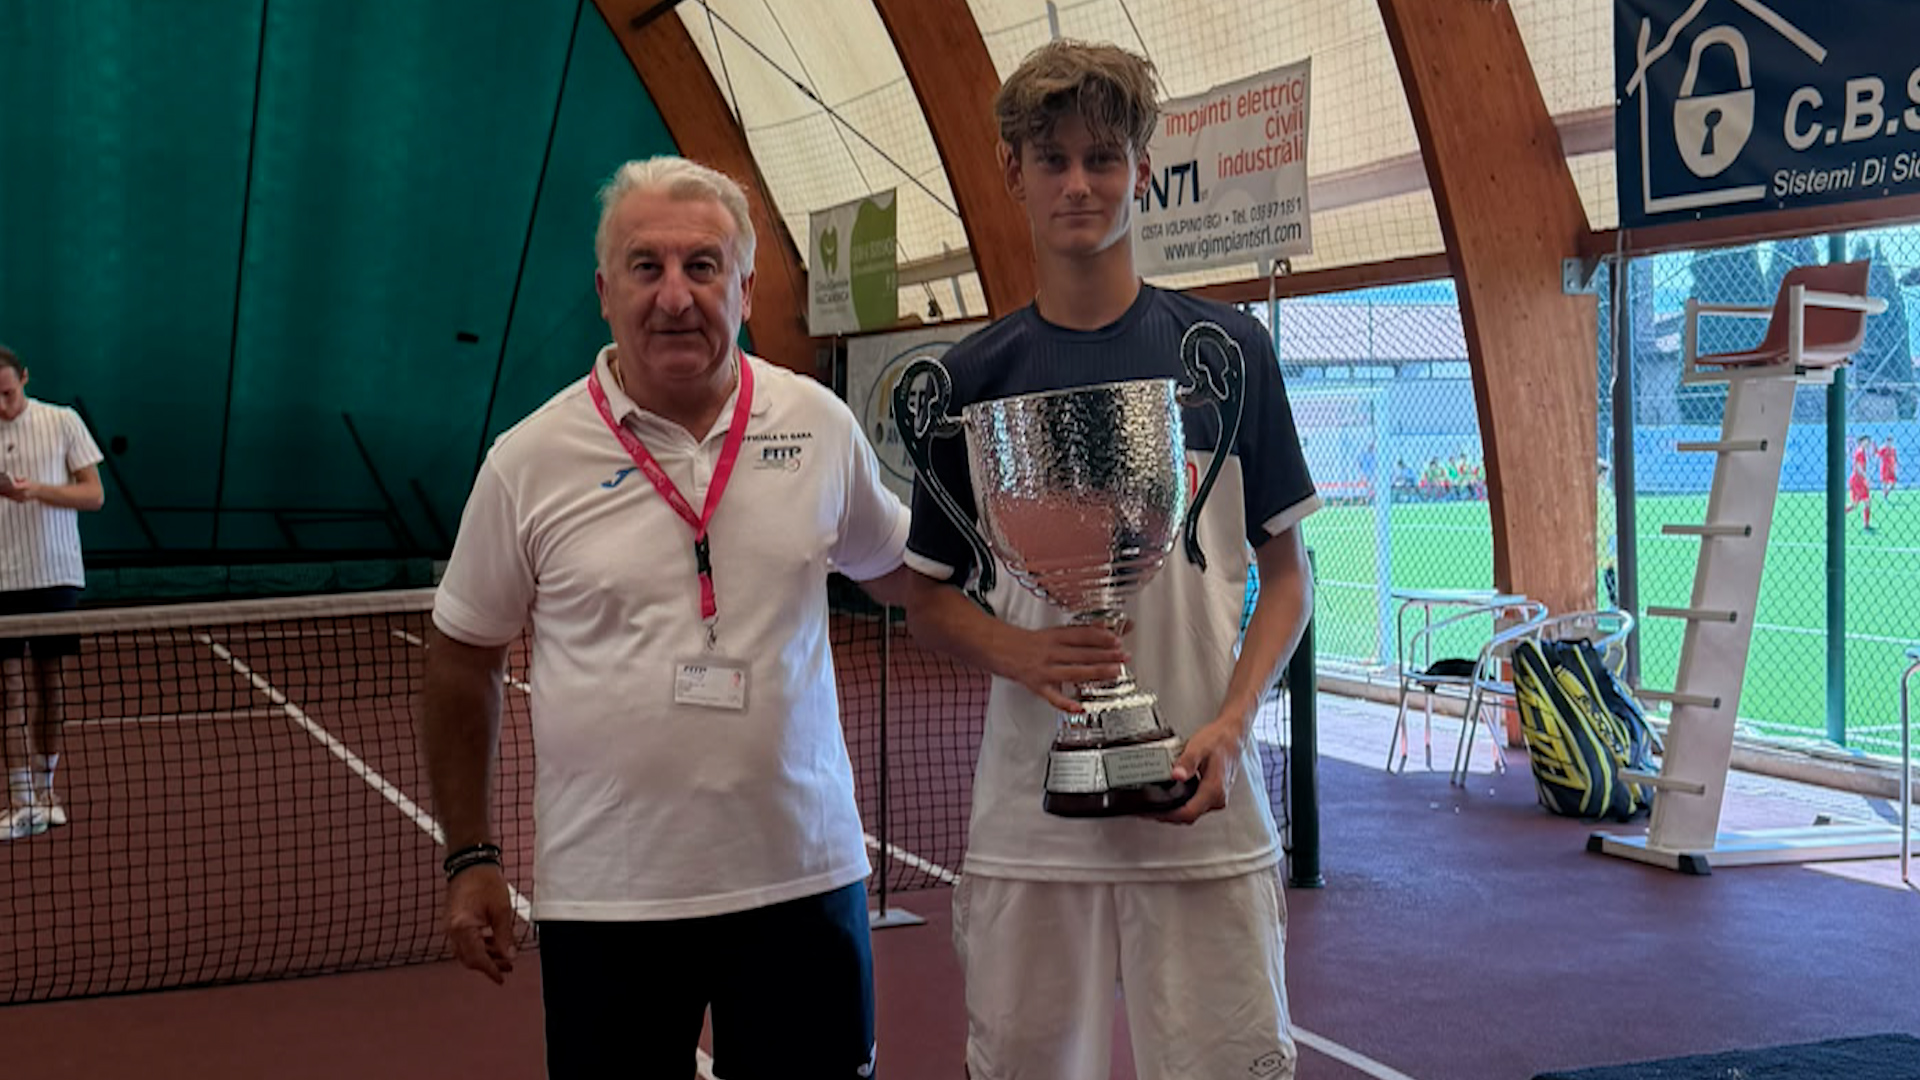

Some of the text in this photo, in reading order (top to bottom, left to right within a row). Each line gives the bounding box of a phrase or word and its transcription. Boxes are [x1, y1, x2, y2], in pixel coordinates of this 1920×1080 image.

[1236, 72, 1305, 118] elettrici
[1265, 102, 1303, 140] civili
[1218, 133, 1303, 179] industriali
[1773, 161, 1856, 196] Sistemi
[1861, 156, 1887, 186] Di
[1164, 222, 1302, 261] www.igimpiantisrl.com
[1165, 216, 1201, 236] VOLPINO
